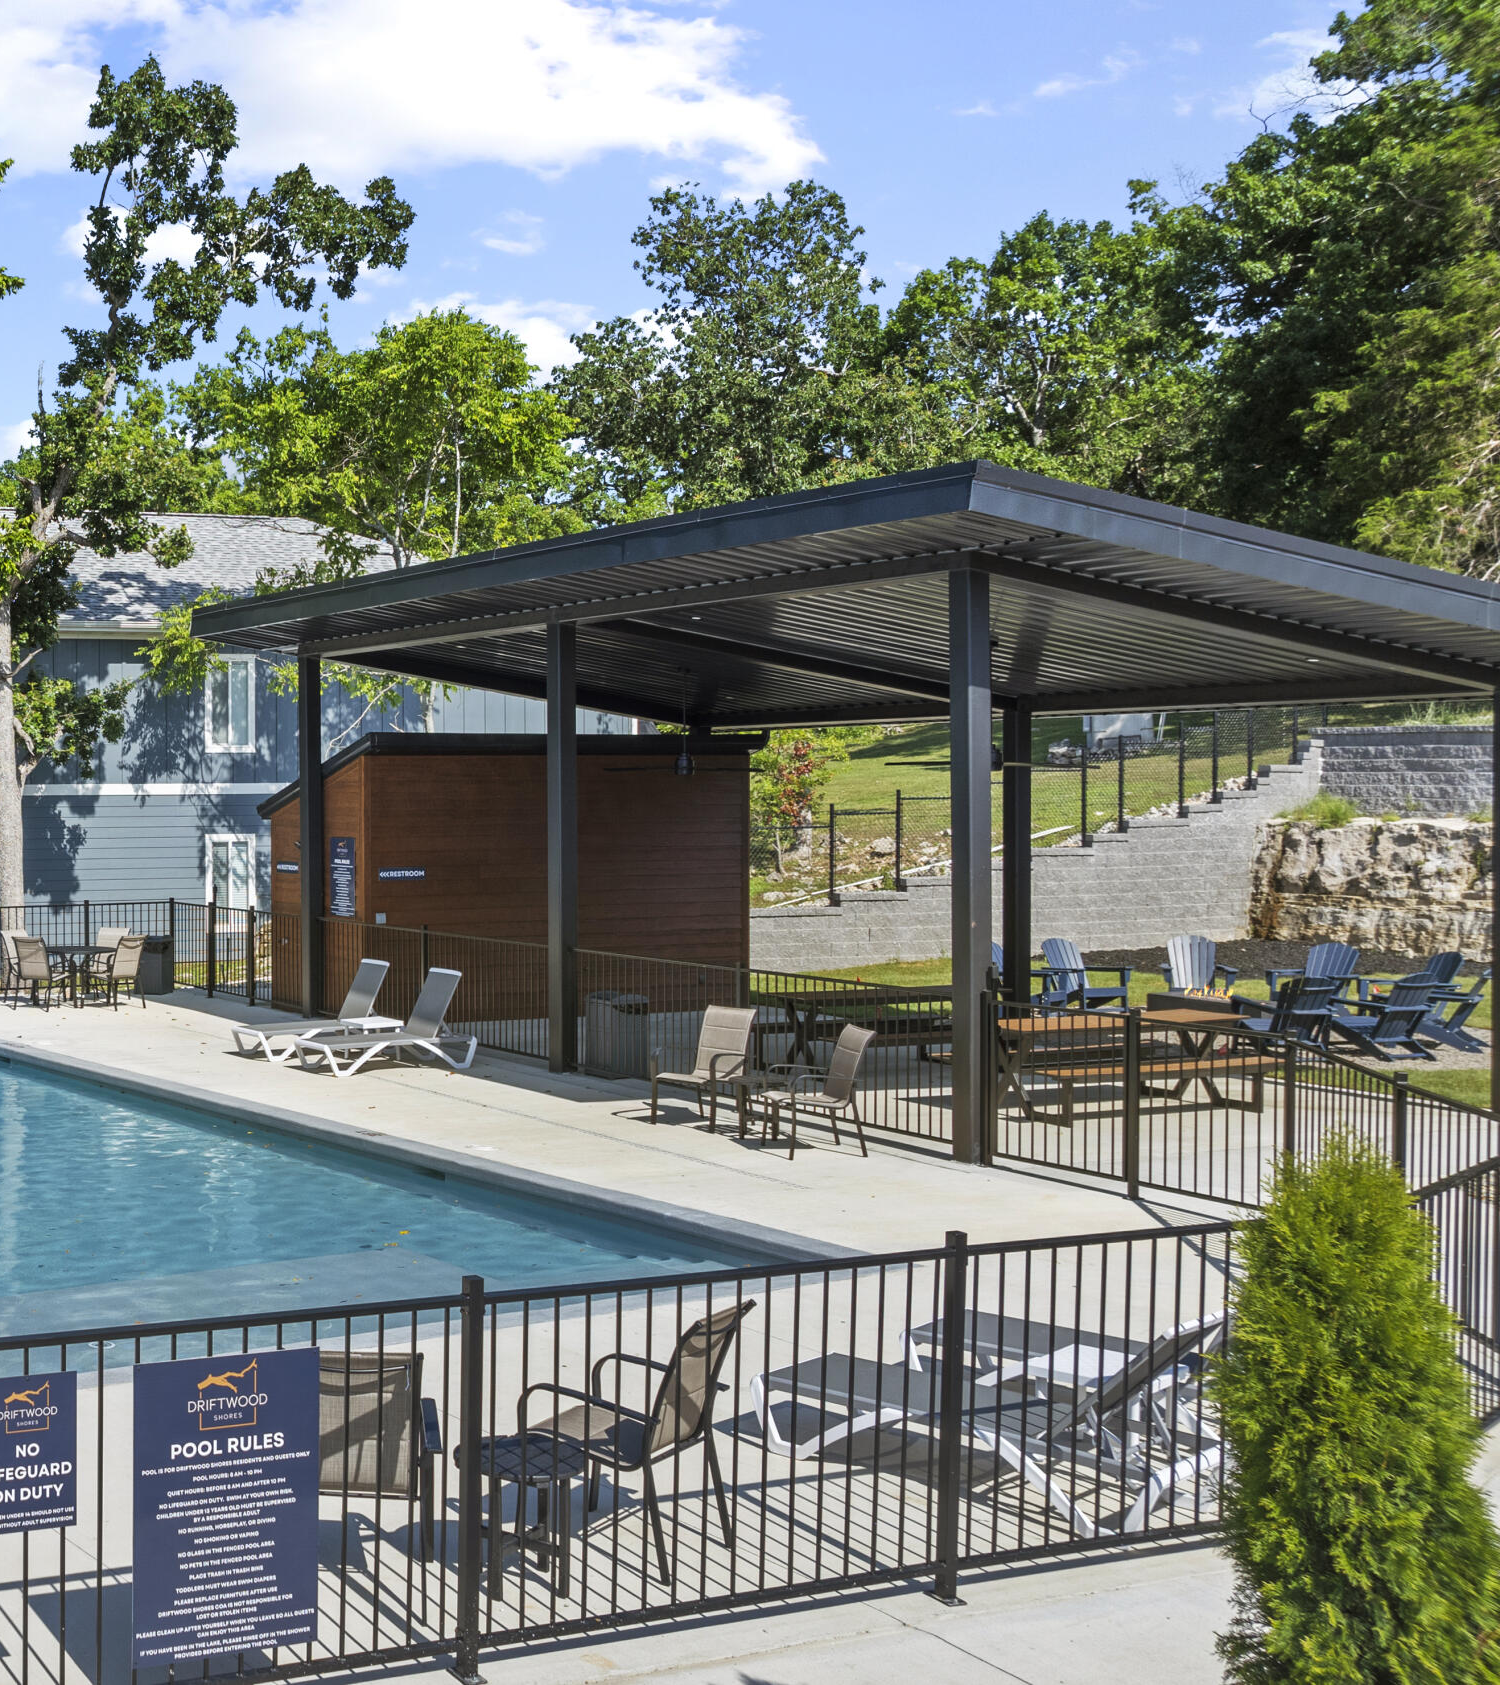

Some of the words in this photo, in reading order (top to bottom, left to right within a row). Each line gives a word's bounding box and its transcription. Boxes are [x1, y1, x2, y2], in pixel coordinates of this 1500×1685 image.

[188, 1393, 268, 1413] DRIFTWOOD
[214, 1412, 243, 1421] SHORES
[16, 1443, 40, 1458] NO
[170, 1440, 223, 1460] POOL
[228, 1432, 285, 1453] RULES
[142, 1468, 156, 1476] POOL
[176, 1462, 209, 1472] DRIFTWOOD
[211, 1460, 231, 1468] SHORES
[233, 1456, 261, 1465] RESIDENTS
[275, 1452, 294, 1460] GUESTS
[20, 1483, 64, 1500] DUTY
[206, 1484, 226, 1492] BEFORE
[156, 1511, 183, 1519] CHILDREN
[185, 1508, 203, 1516] UNDER
[264, 1497, 295, 1506] SUPERVISED
[168, 1499, 198, 1508] LIFEGUARD
[39, 1515, 72, 1523] SUPERVISION
[206, 1511, 241, 1521] RESPONSIBLE
[203, 1534, 229, 1543] SMOKING
[223, 1544, 244, 1552] FENCED
[221, 1556, 242, 1564] FENCED
[189, 1572, 206, 1580] PLACE
[233, 1566, 249, 1574] TRASH
[176, 1584, 204, 1593] TODDLERS
[254, 1575, 275, 1583] DIAPERS
[174, 1597, 193, 1605] PLEASE
[194, 1594, 218, 1602] REPLACE
[219, 1590, 248, 1599] FURNITURE
[250, 1587, 266, 1595] AFTER
[158, 1607, 191, 1617] DRIFTWOOD
[192, 1604, 214, 1612] SHORES
[246, 1595, 280, 1605] RESPONSIBLE
[219, 1608, 239, 1616] STOLEN
[136, 1631, 155, 1639] PLEASE
[157, 1628, 175, 1636] CLEAN
[184, 1624, 201, 1632] AFTER
[202, 1620, 228, 1629] YOURSELF
[294, 1608, 314, 1616] GUESTS
[210, 1628, 226, 1636] ENJOY
[158, 1646, 172, 1654] HAVE
[222, 1636, 241, 1644] PLEASE
[287, 1626, 310, 1635] SHOWER
[174, 1649, 201, 1658] PROVIDED
[203, 1646, 223, 1654] BEFORE
[224, 1642, 250, 1651] ENTERING
[262, 1638, 276, 1646] POOL
